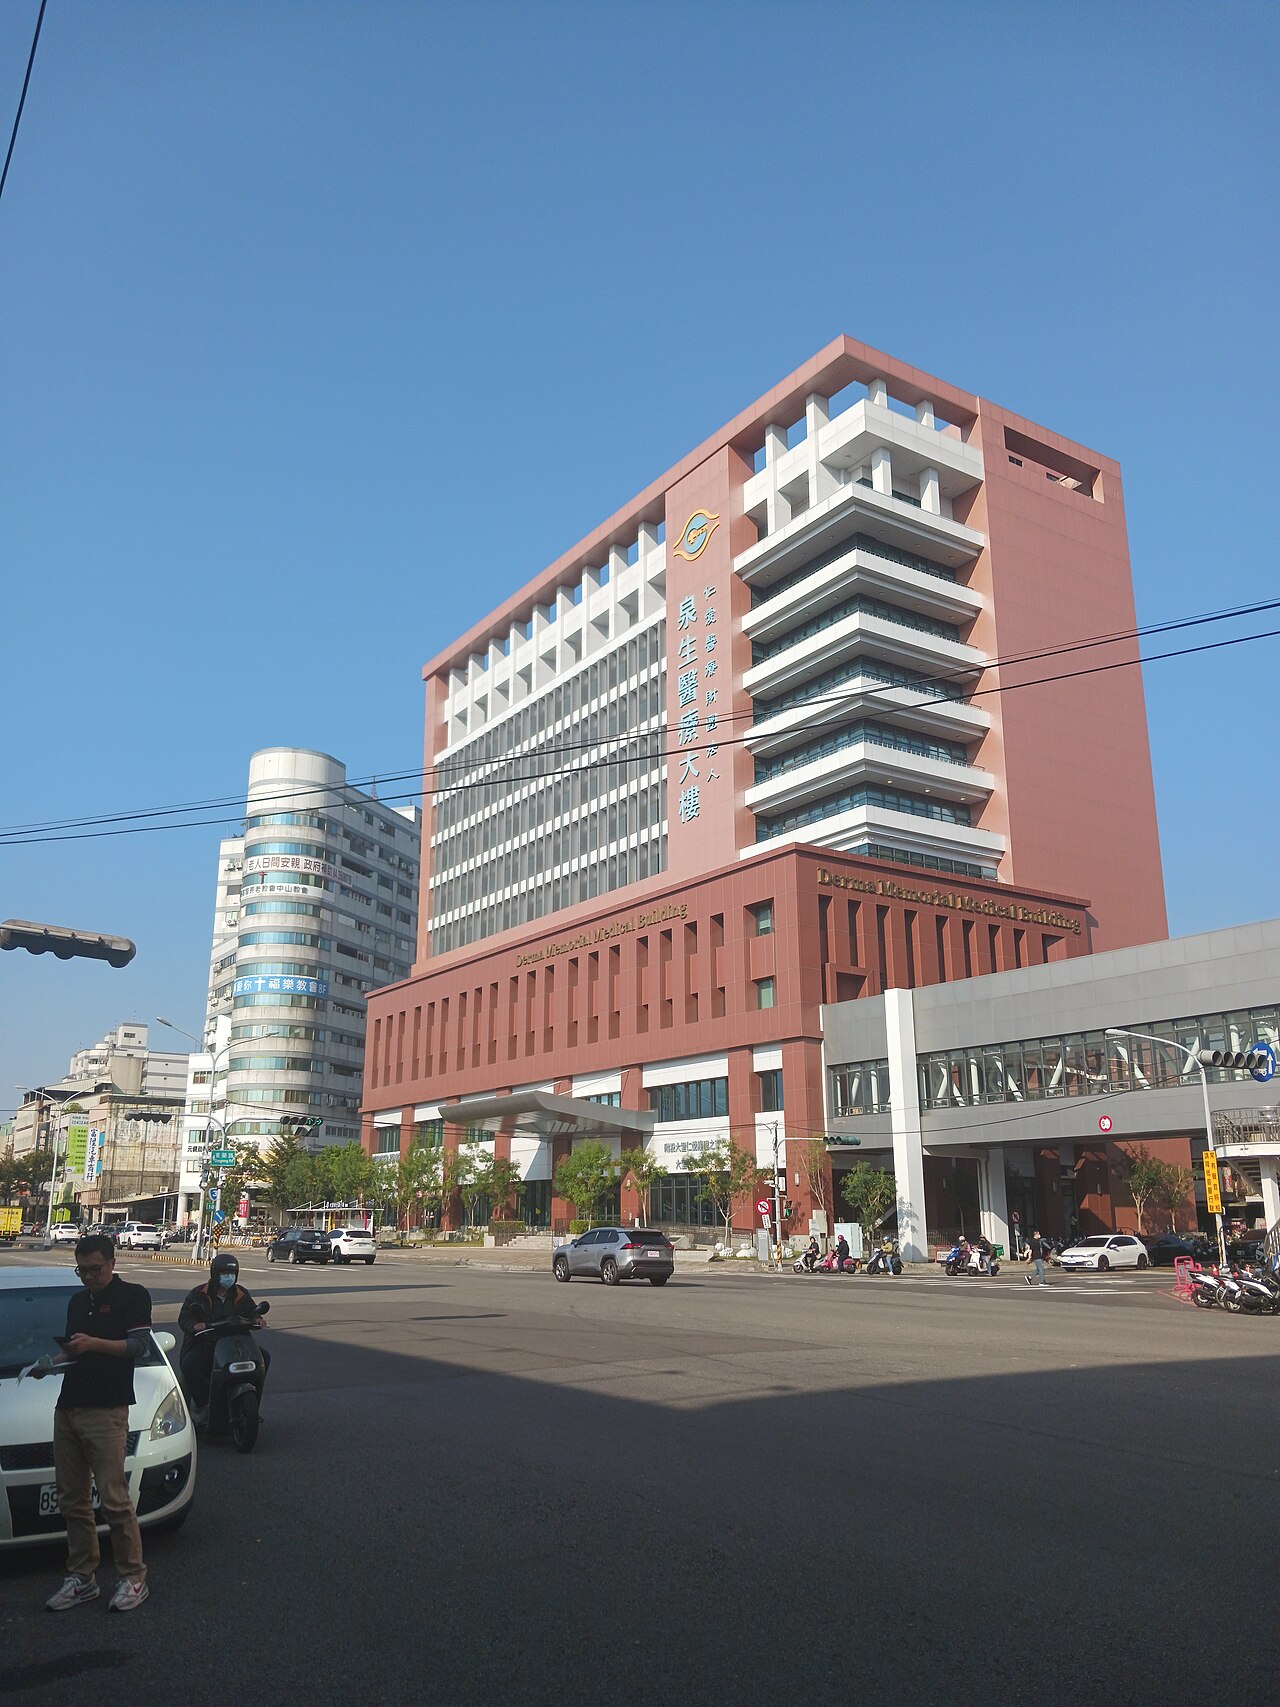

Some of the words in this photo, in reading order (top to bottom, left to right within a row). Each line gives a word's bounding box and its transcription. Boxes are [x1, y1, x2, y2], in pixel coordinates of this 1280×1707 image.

[677, 594, 701, 824] 泉生醫療大樓
[248, 856, 301, 871] 老人日間安親
[593, 917, 636, 943] Medical
[637, 903, 688, 930] Building
[816, 867, 876, 894] Derma
[877, 879, 957, 911] Memorial
[957, 895, 1017, 920] Medical
[1017, 905, 1081, 935] Building
